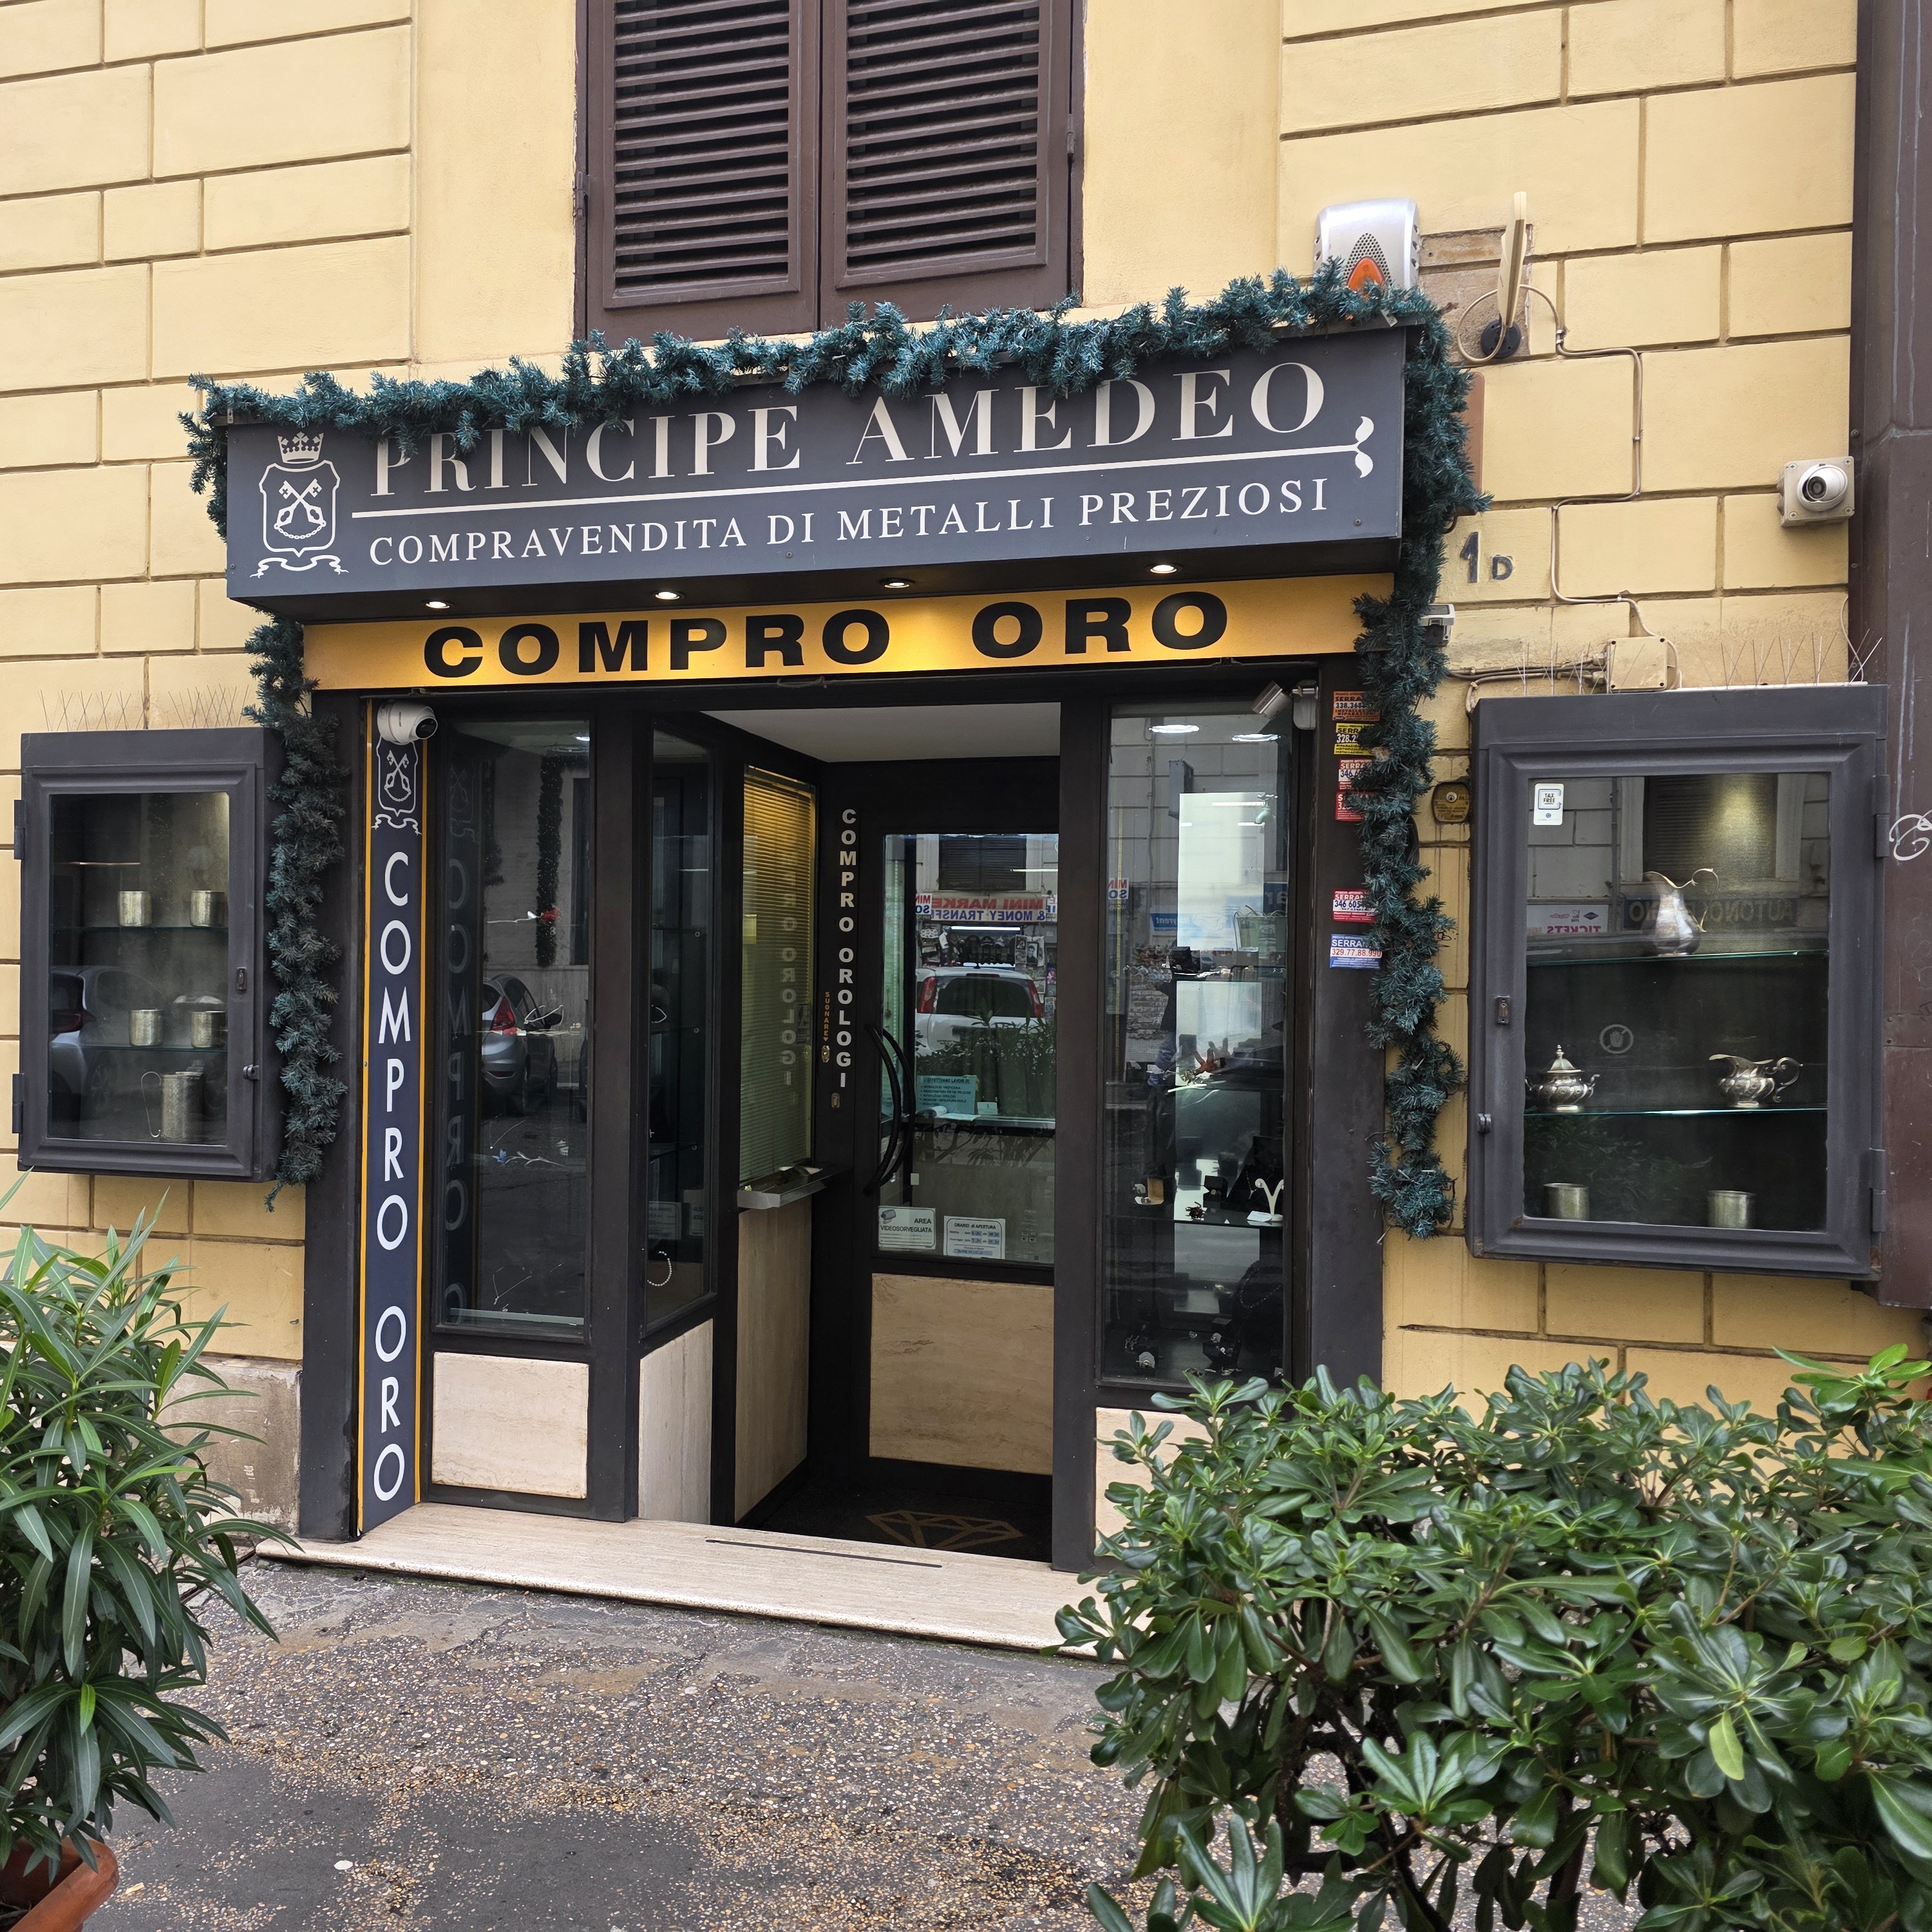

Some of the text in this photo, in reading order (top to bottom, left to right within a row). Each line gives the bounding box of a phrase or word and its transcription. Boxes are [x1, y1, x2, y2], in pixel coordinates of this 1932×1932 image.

[370, 362, 1325, 497] PRINCIPE AMEDEO
[370, 478, 1328, 565] COMPRAVENDITA DI METALLI PREZIOSI
[424, 591, 1228, 678] COMPRO ORO
[1334, 900, 1347, 908] 346
[836, 808, 857, 1088] COMPRO OROLOGI
[374, 851, 412, 1501] COMPRO ORO
[880, 1225, 933, 1233] VIDEOSORVEGLIATA
